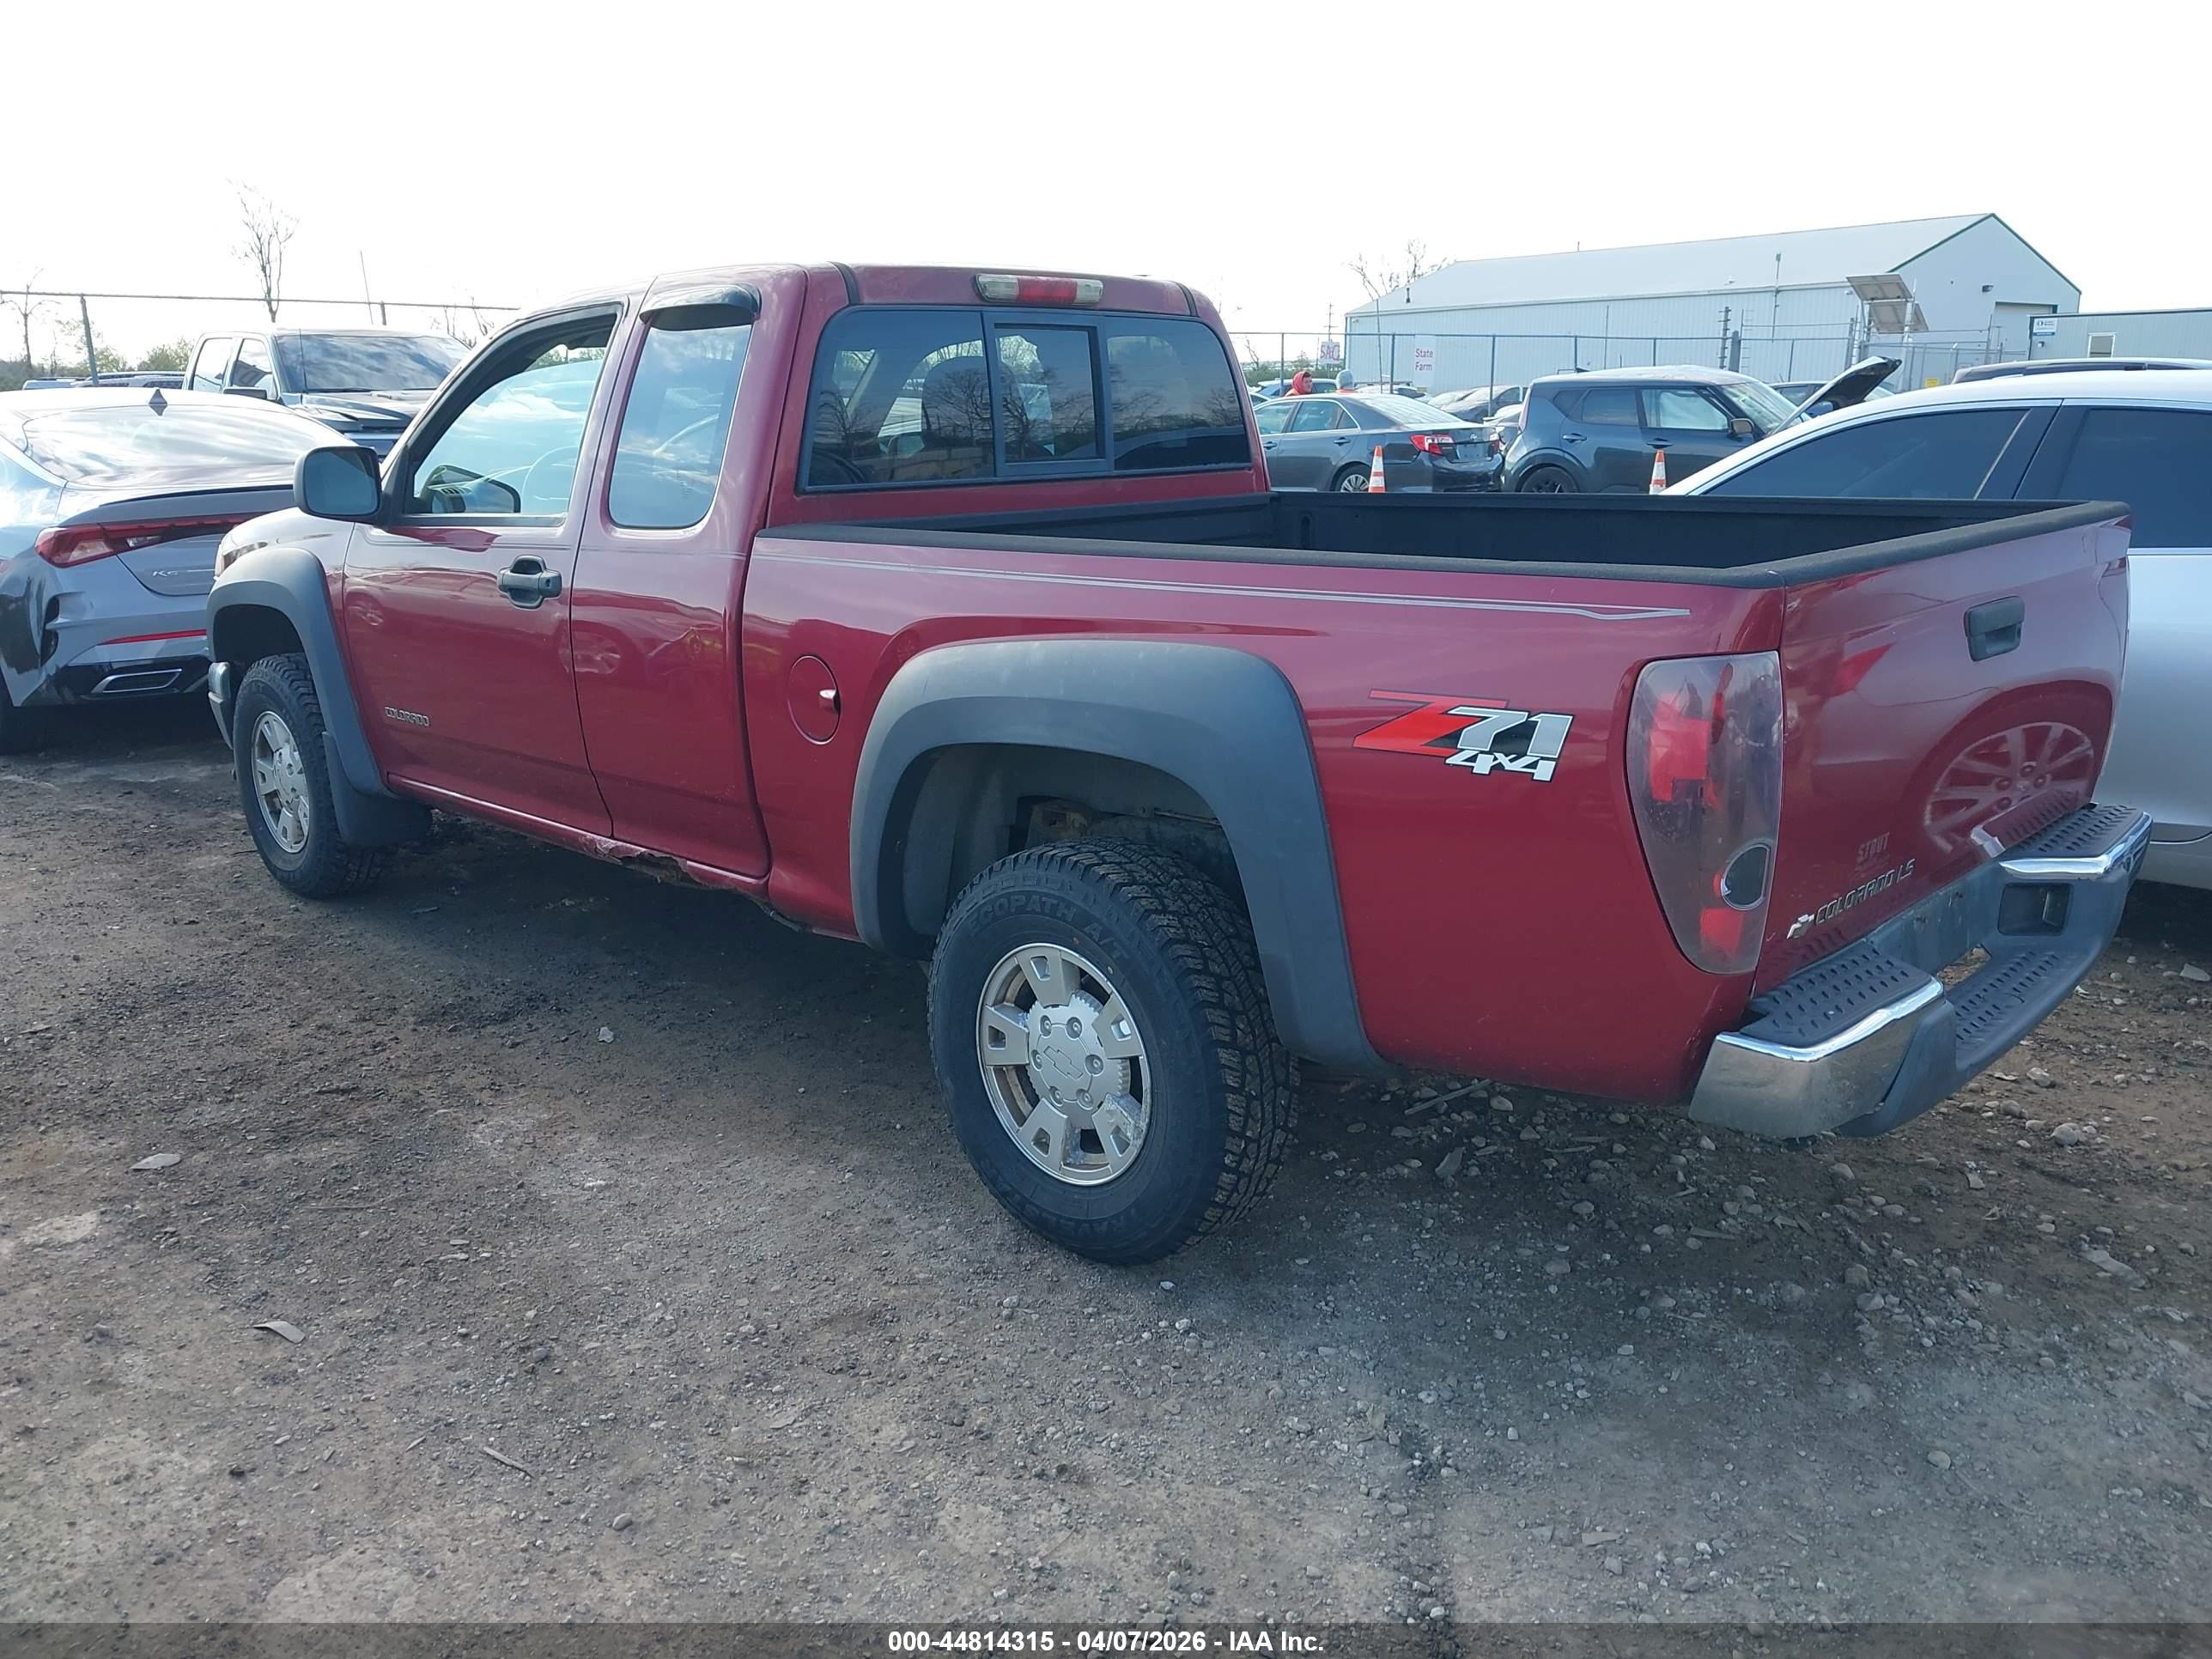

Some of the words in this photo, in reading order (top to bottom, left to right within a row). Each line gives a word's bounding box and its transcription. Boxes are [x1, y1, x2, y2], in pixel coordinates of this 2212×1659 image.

[1414, 361, 1433, 372] Farm
[1415, 348, 1434, 358] State
[384, 706, 430, 727] COLORADO
[1352, 688, 1575, 759] Z71
[1815, 869, 1895, 926] COLORADO
[1896, 858, 1916, 884] LS
[968, 895, 1077, 934] ECOPATH
